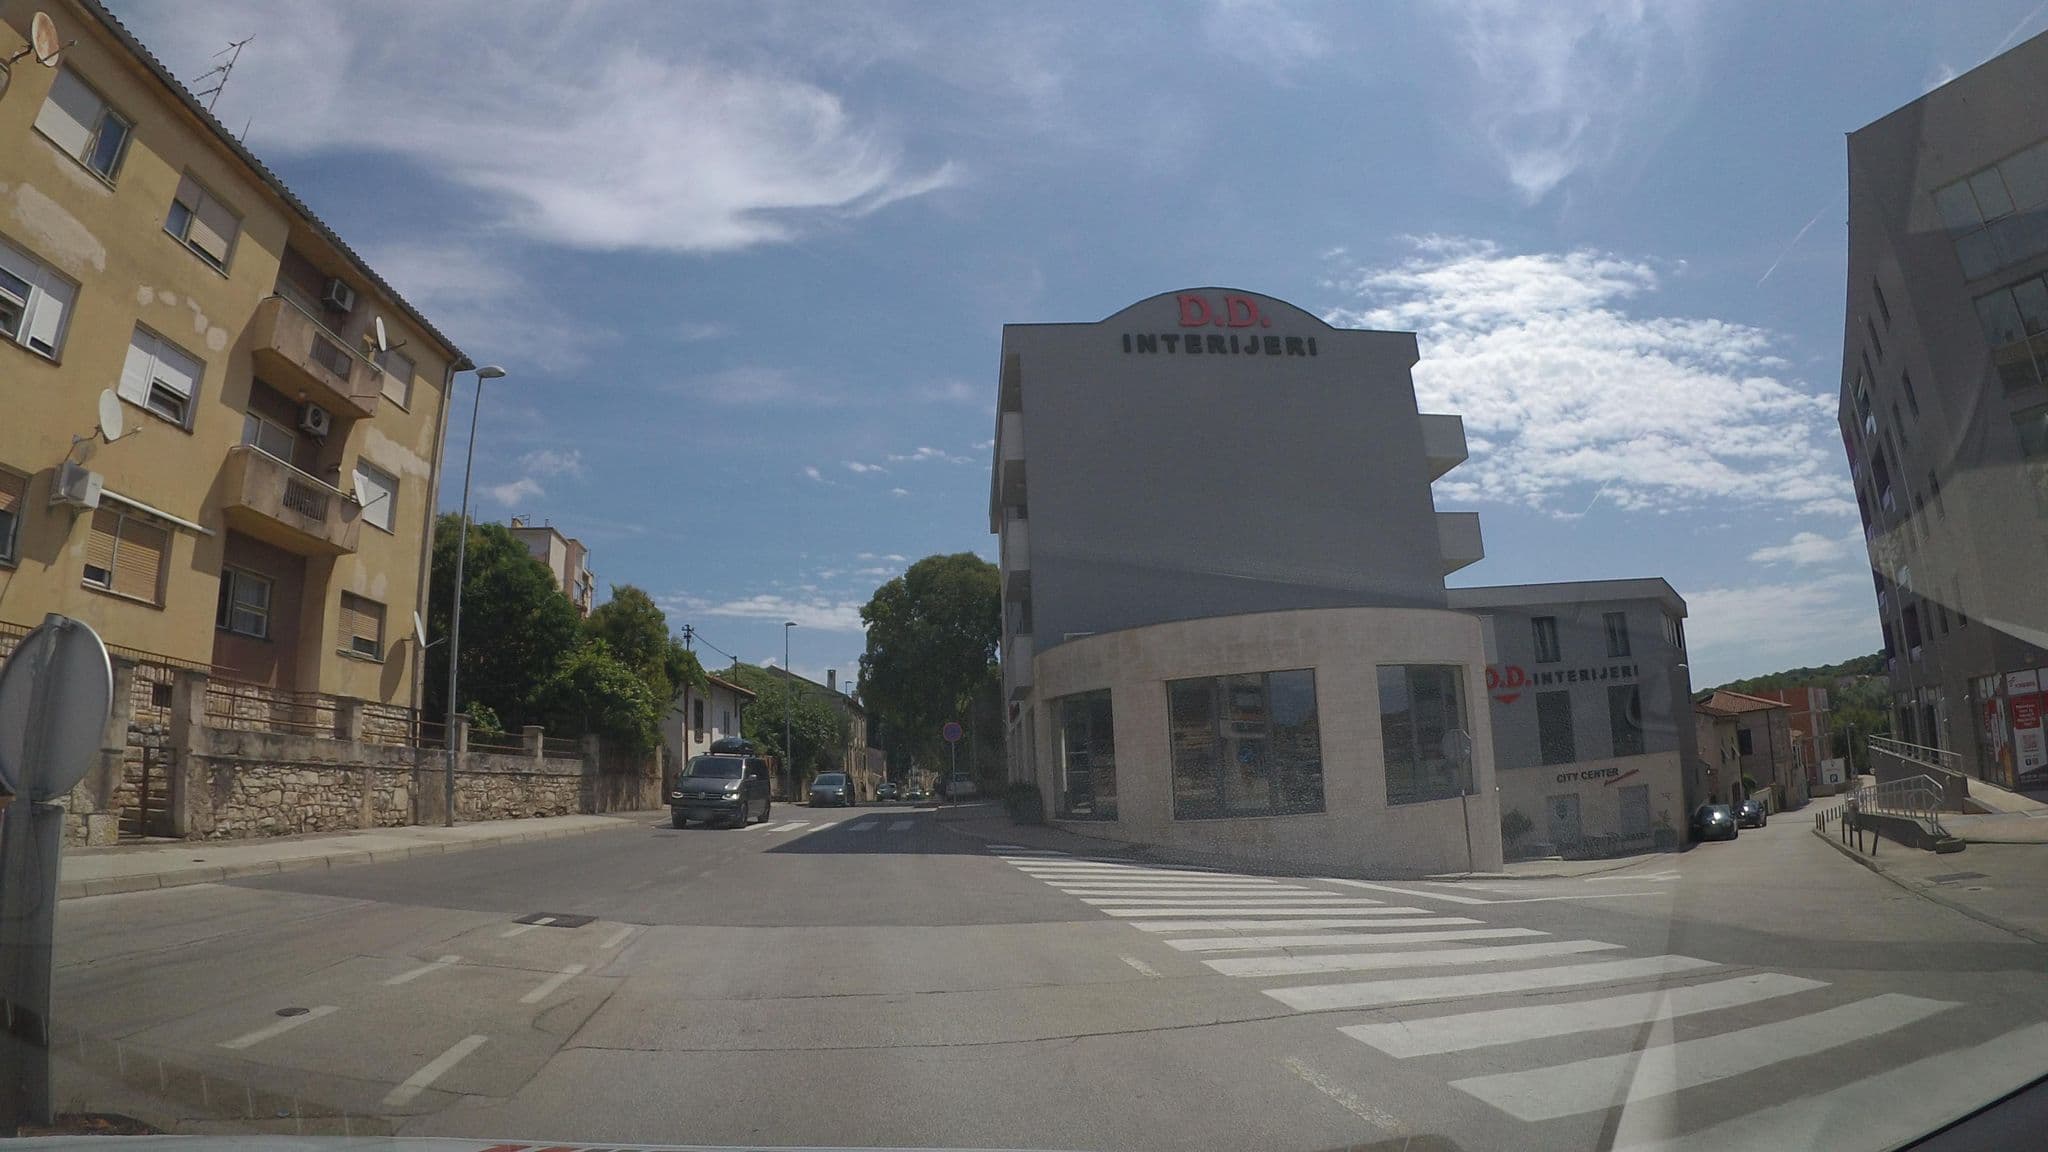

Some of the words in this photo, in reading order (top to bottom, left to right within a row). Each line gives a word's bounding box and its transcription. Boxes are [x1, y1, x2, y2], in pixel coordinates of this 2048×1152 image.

[1177, 295, 1271, 327] D.D.
[1122, 333, 1318, 356] INTERIJERI
[1533, 665, 1639, 686] INTERIJERI
[1556, 772, 1578, 784] CITY
[1581, 768, 1619, 780] CENTER
